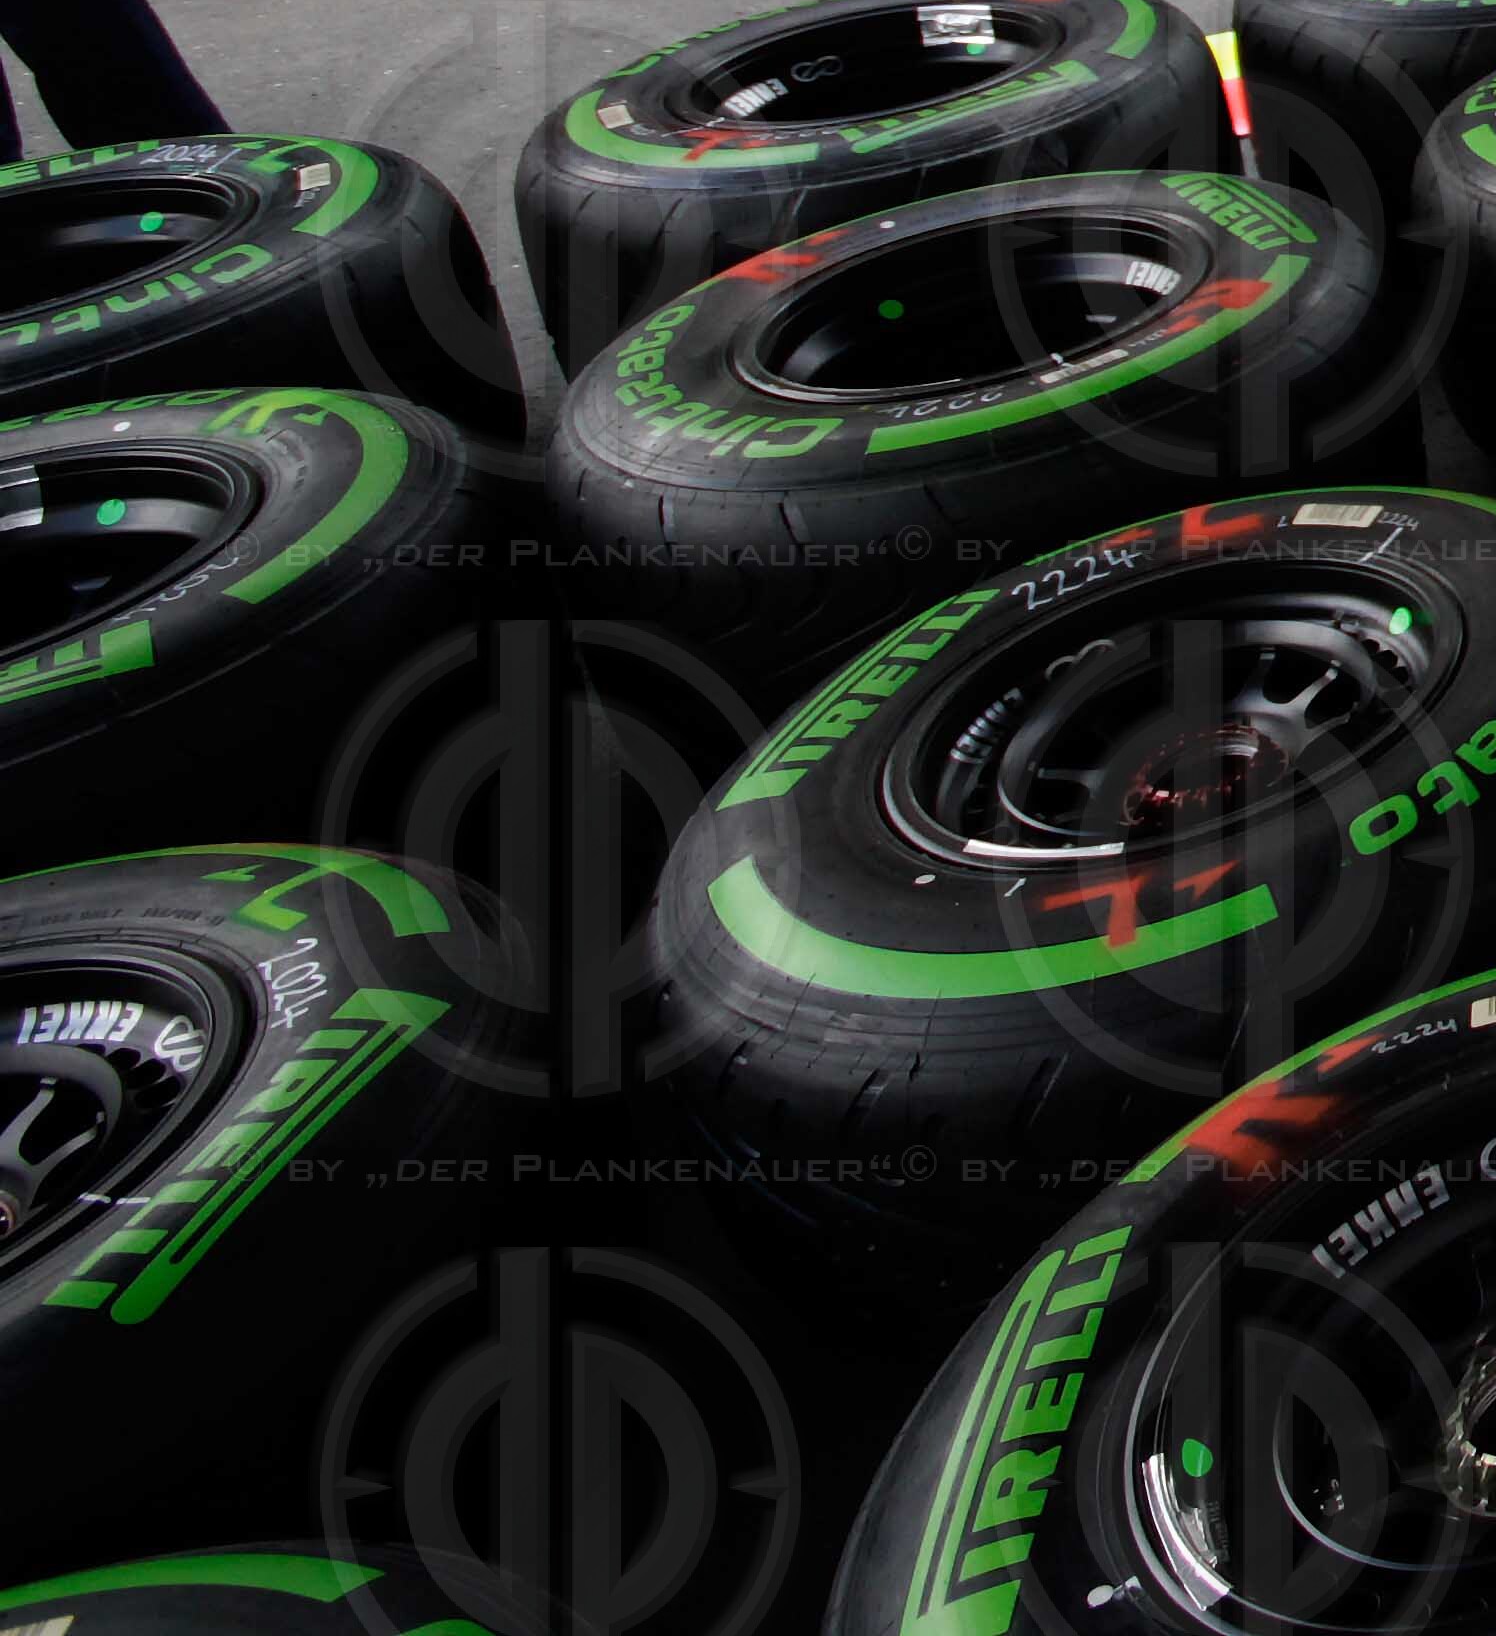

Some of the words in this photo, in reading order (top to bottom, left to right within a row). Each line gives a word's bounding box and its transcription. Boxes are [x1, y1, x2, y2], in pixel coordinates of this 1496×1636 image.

[1160, 172, 1318, 252] PIRELLI
[1011, 546, 1144, 612] 2224
[716, 587, 1000, 811] PIRELLI
[1371, 1017, 1458, 1056] 2224
[43, 988, 452, 1324] PIRELLI
[900, 1224, 1133, 1636] PIRELLI
